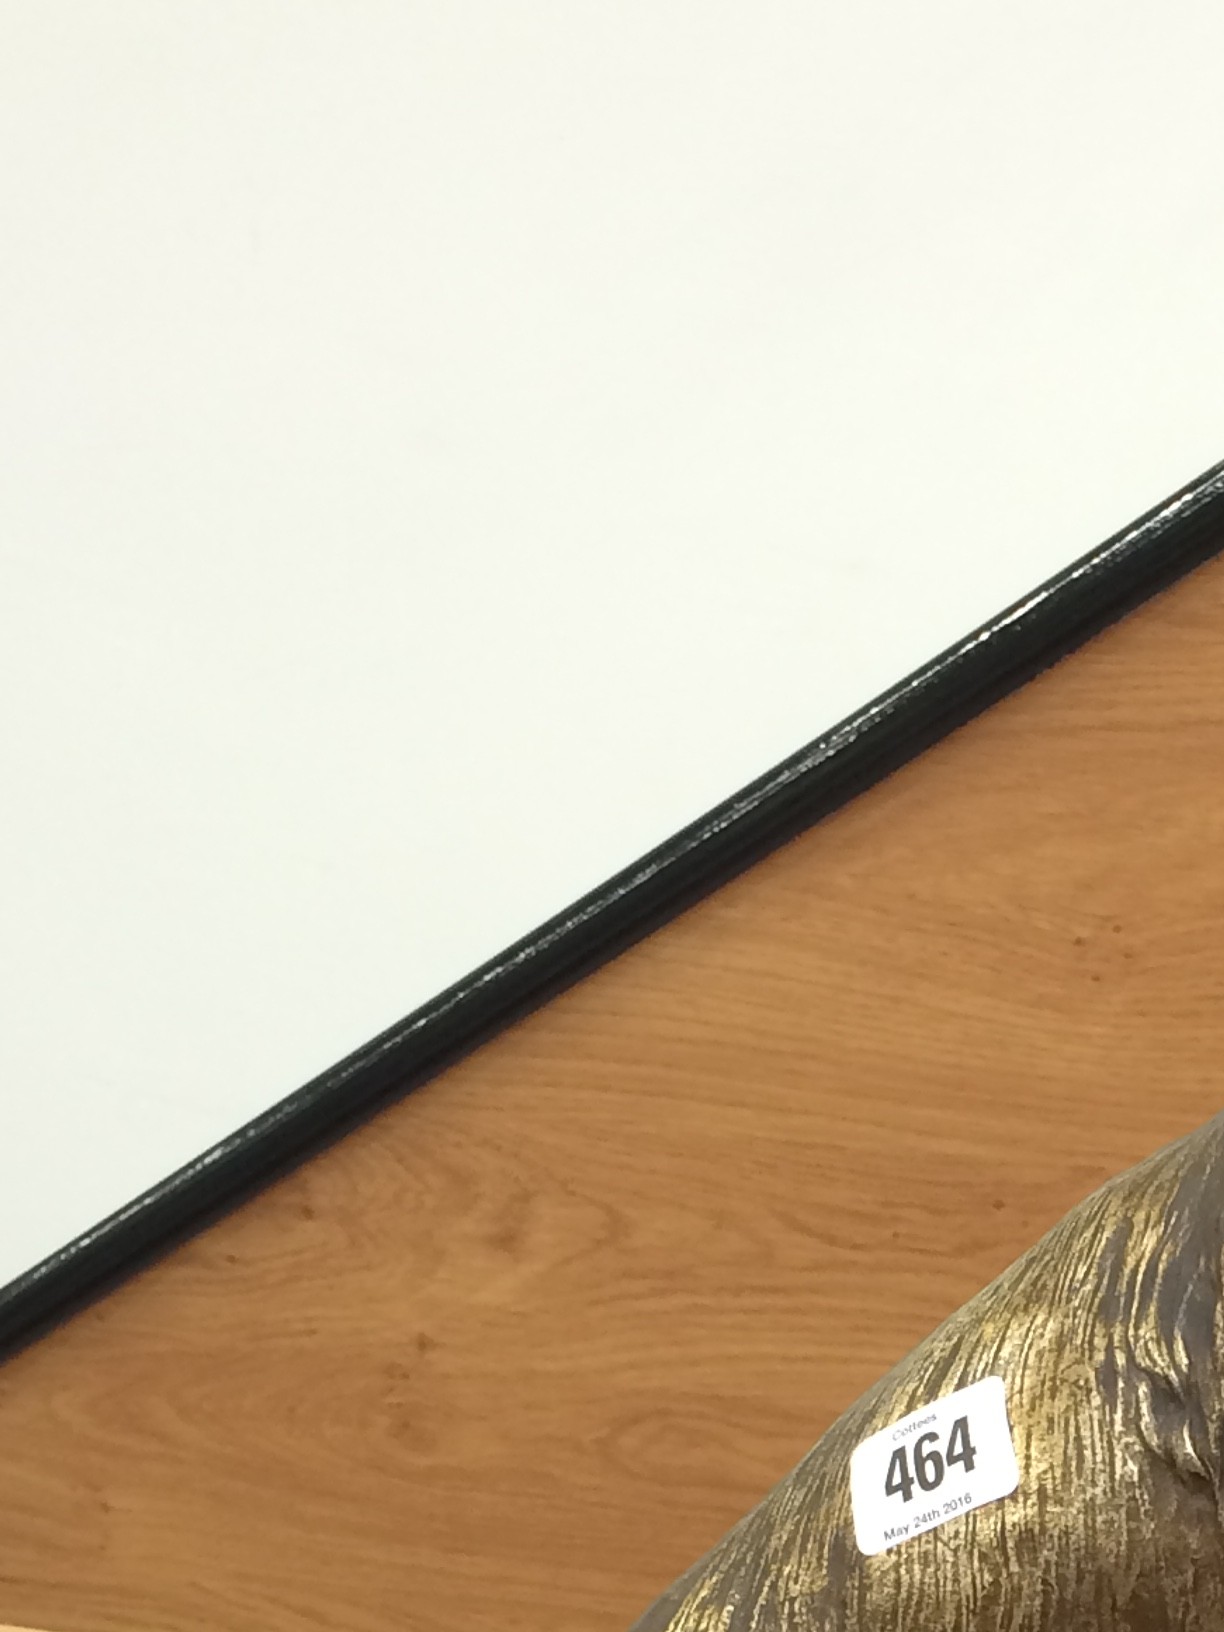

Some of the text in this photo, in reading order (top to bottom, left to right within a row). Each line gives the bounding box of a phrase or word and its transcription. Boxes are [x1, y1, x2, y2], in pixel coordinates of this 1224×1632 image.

[885, 1415, 977, 1503] 464
[883, 1492, 973, 1541] May 24th 2016
